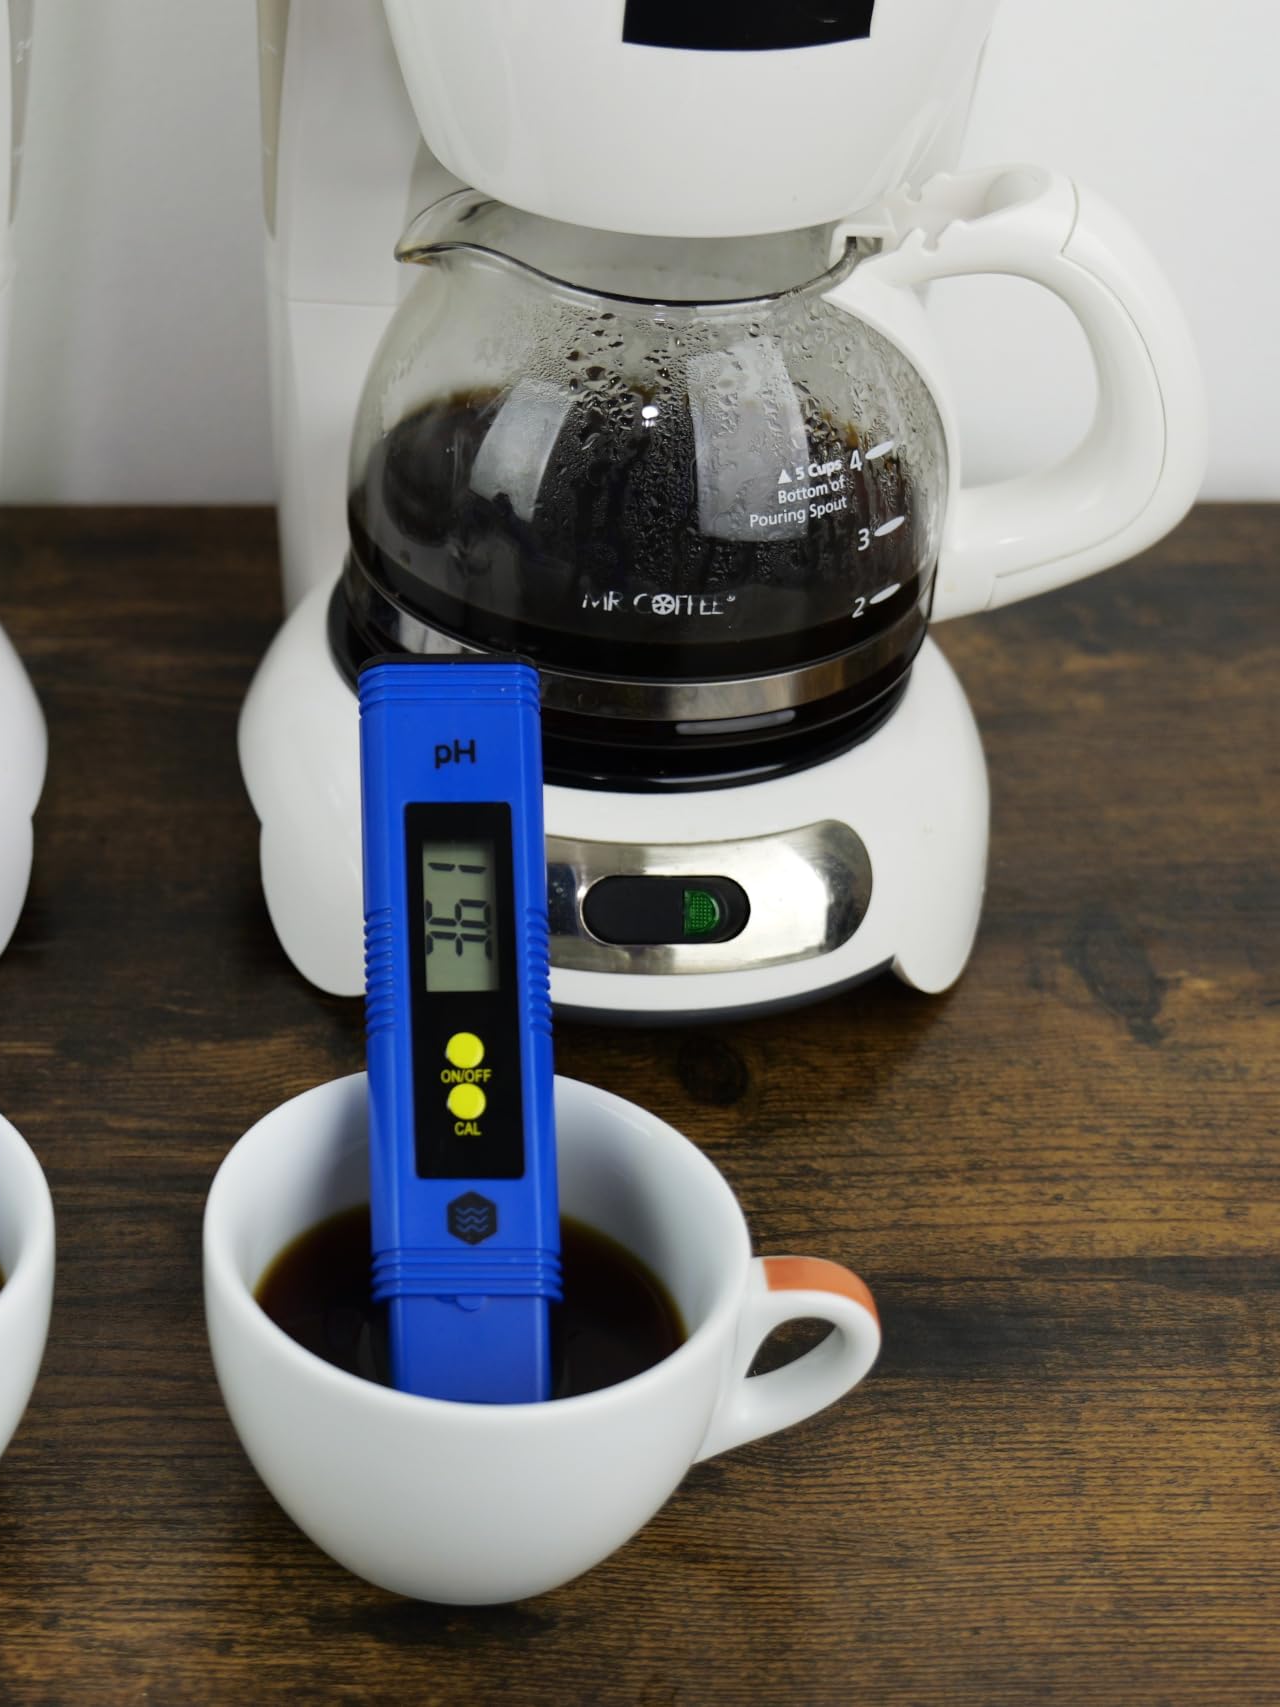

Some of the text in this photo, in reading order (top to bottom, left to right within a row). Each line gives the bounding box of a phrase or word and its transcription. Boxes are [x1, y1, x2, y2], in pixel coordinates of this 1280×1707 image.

[795, 460, 843, 481] 5 Cups
[849, 450, 863, 471] 4
[778, 475, 846, 505] Bottom of
[750, 496, 847, 529] Pouring Spout
[857, 528, 870, 550] 3
[851, 598, 866, 618] 2
[434, 739, 476, 769] pH
[440, 1069, 492, 1083] ON/OFF
[454, 1122, 482, 1135] CAL
